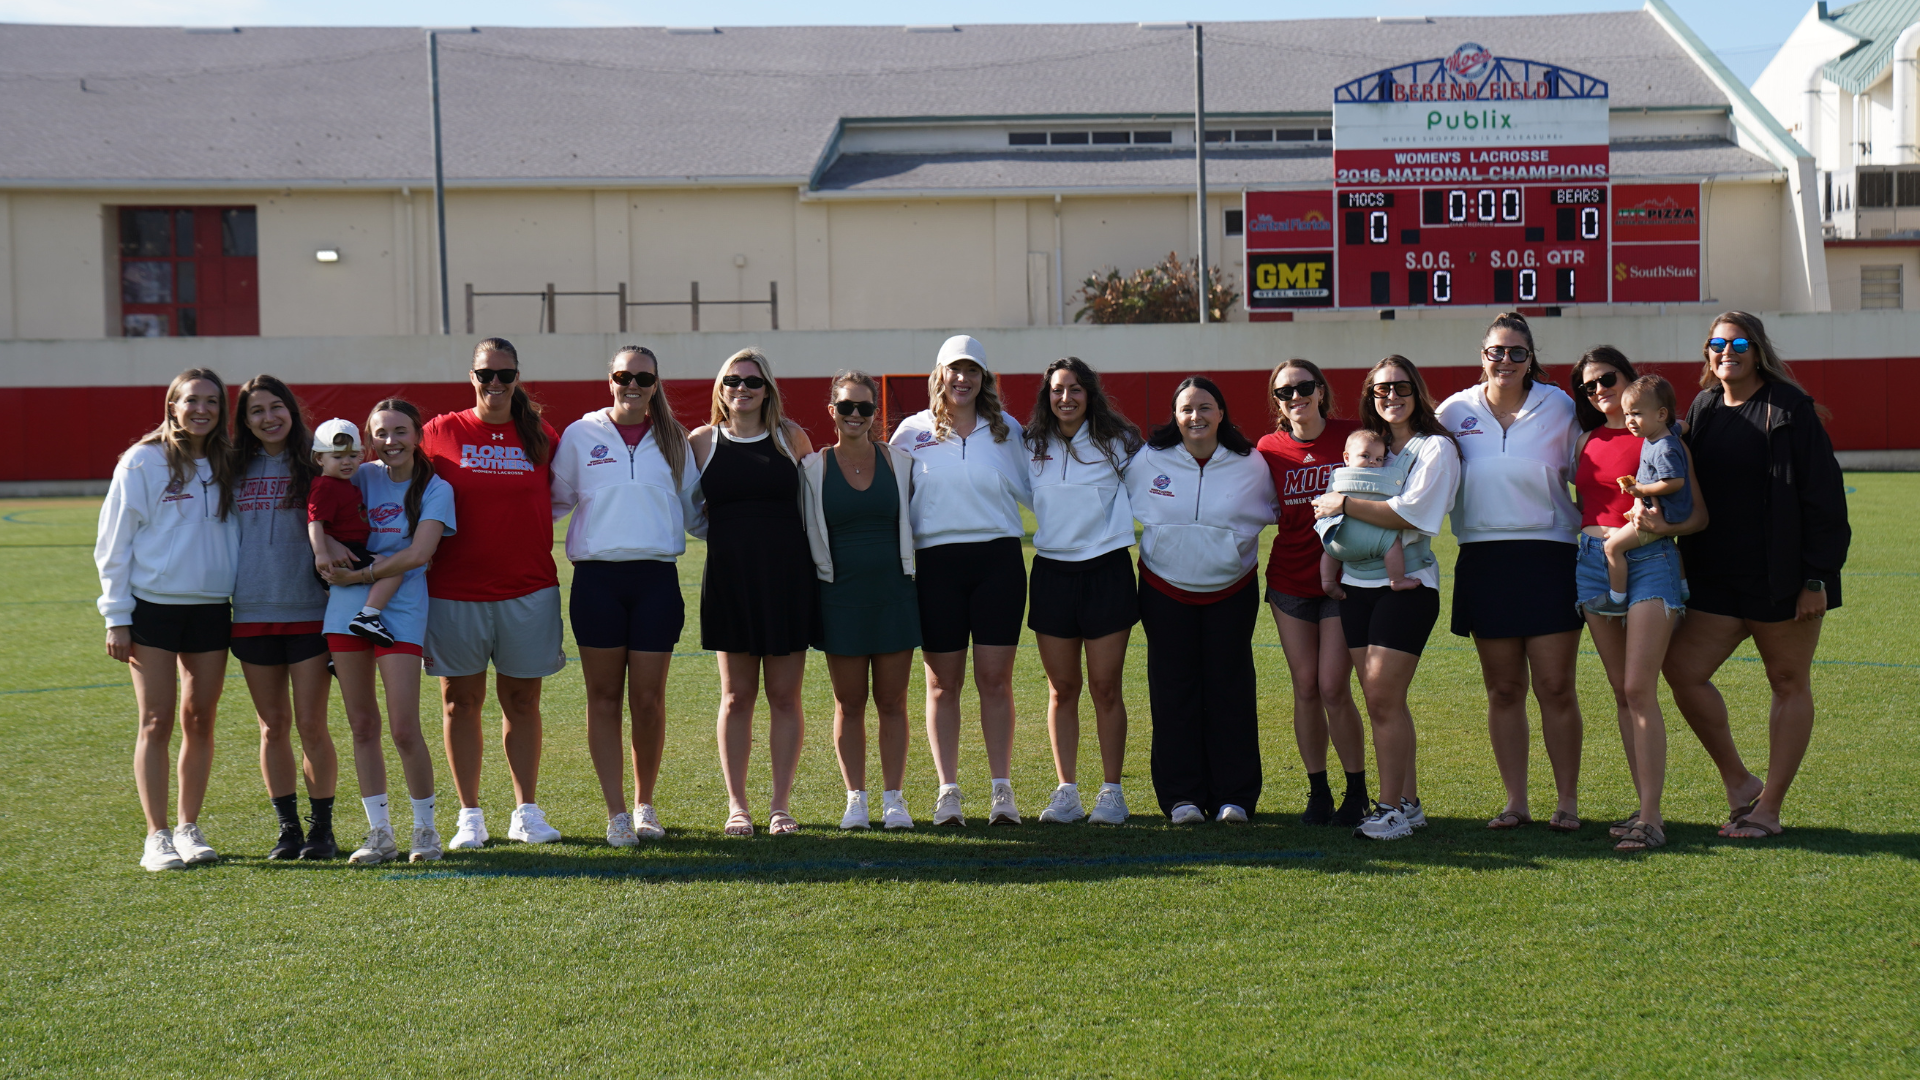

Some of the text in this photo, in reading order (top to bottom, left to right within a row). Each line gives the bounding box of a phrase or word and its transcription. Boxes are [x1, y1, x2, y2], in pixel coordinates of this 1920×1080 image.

[1445, 49, 1492, 73] Mocs
[1394, 82, 1549, 101] BEREND FIELD
[1427, 110, 1511, 130] Publix
[1395, 150, 1549, 164] WOMEN'S LACROSSE
[1338, 164, 1607, 182] 2016 NATIONAL CHAMPIONS
[1349, 193, 1385, 206] MOCS
[1557, 189, 1599, 203] BEARS
[1648, 209, 1695, 219] PIZZA
[1249, 219, 1330, 232] Central Florida
[1370, 212, 1387, 242] 0
[1582, 208, 1599, 239] 0
[1405, 252, 1455, 269] S.O.G.
[1490, 250, 1540, 268] S.O.G.
[1547, 250, 1585, 265] QTR
[1256, 262, 1326, 290] GMF
[1630, 265, 1697, 278] SouthState
[1433, 271, 1450, 302] 0
[1519, 269, 1537, 300] 0
[1570, 270, 1575, 298] 1
[460, 458, 535, 472] SOUTHERN
[1284, 497, 1313, 506] WOMEN'S
